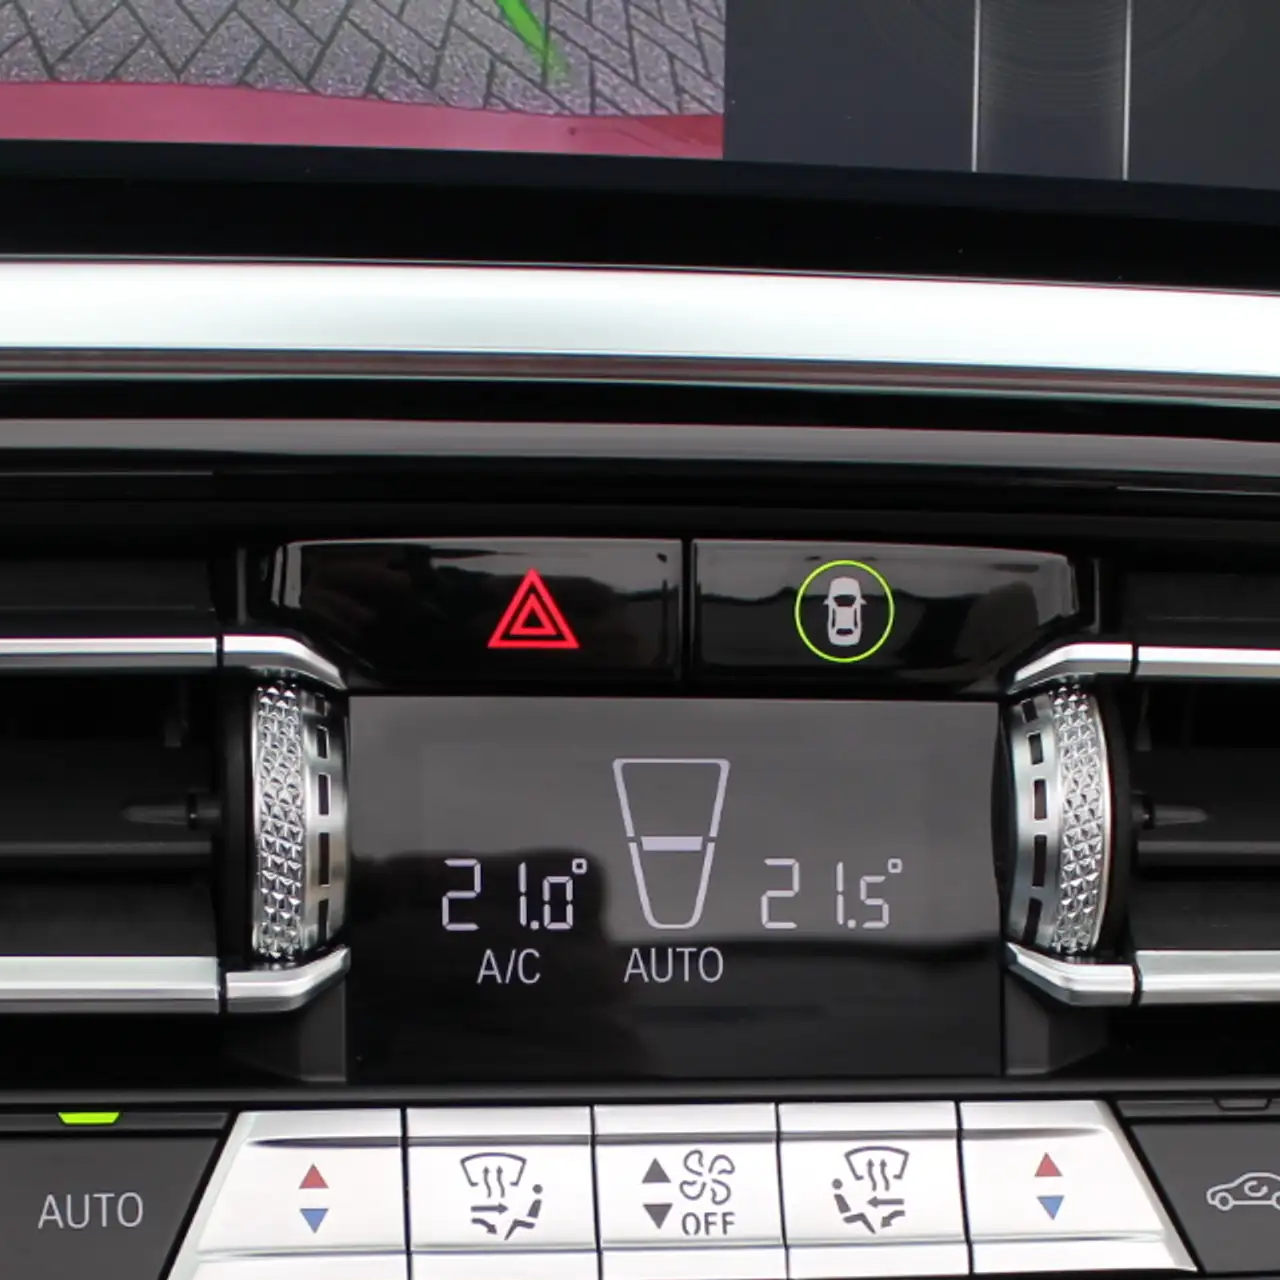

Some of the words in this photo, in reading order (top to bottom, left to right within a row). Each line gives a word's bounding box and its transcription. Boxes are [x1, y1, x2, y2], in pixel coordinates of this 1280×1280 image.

[476, 948, 541, 984] A/C
[623, 946, 724, 983] AUTO
[37, 1192, 144, 1229] AUTO
[681, 1211, 735, 1236] OFF
